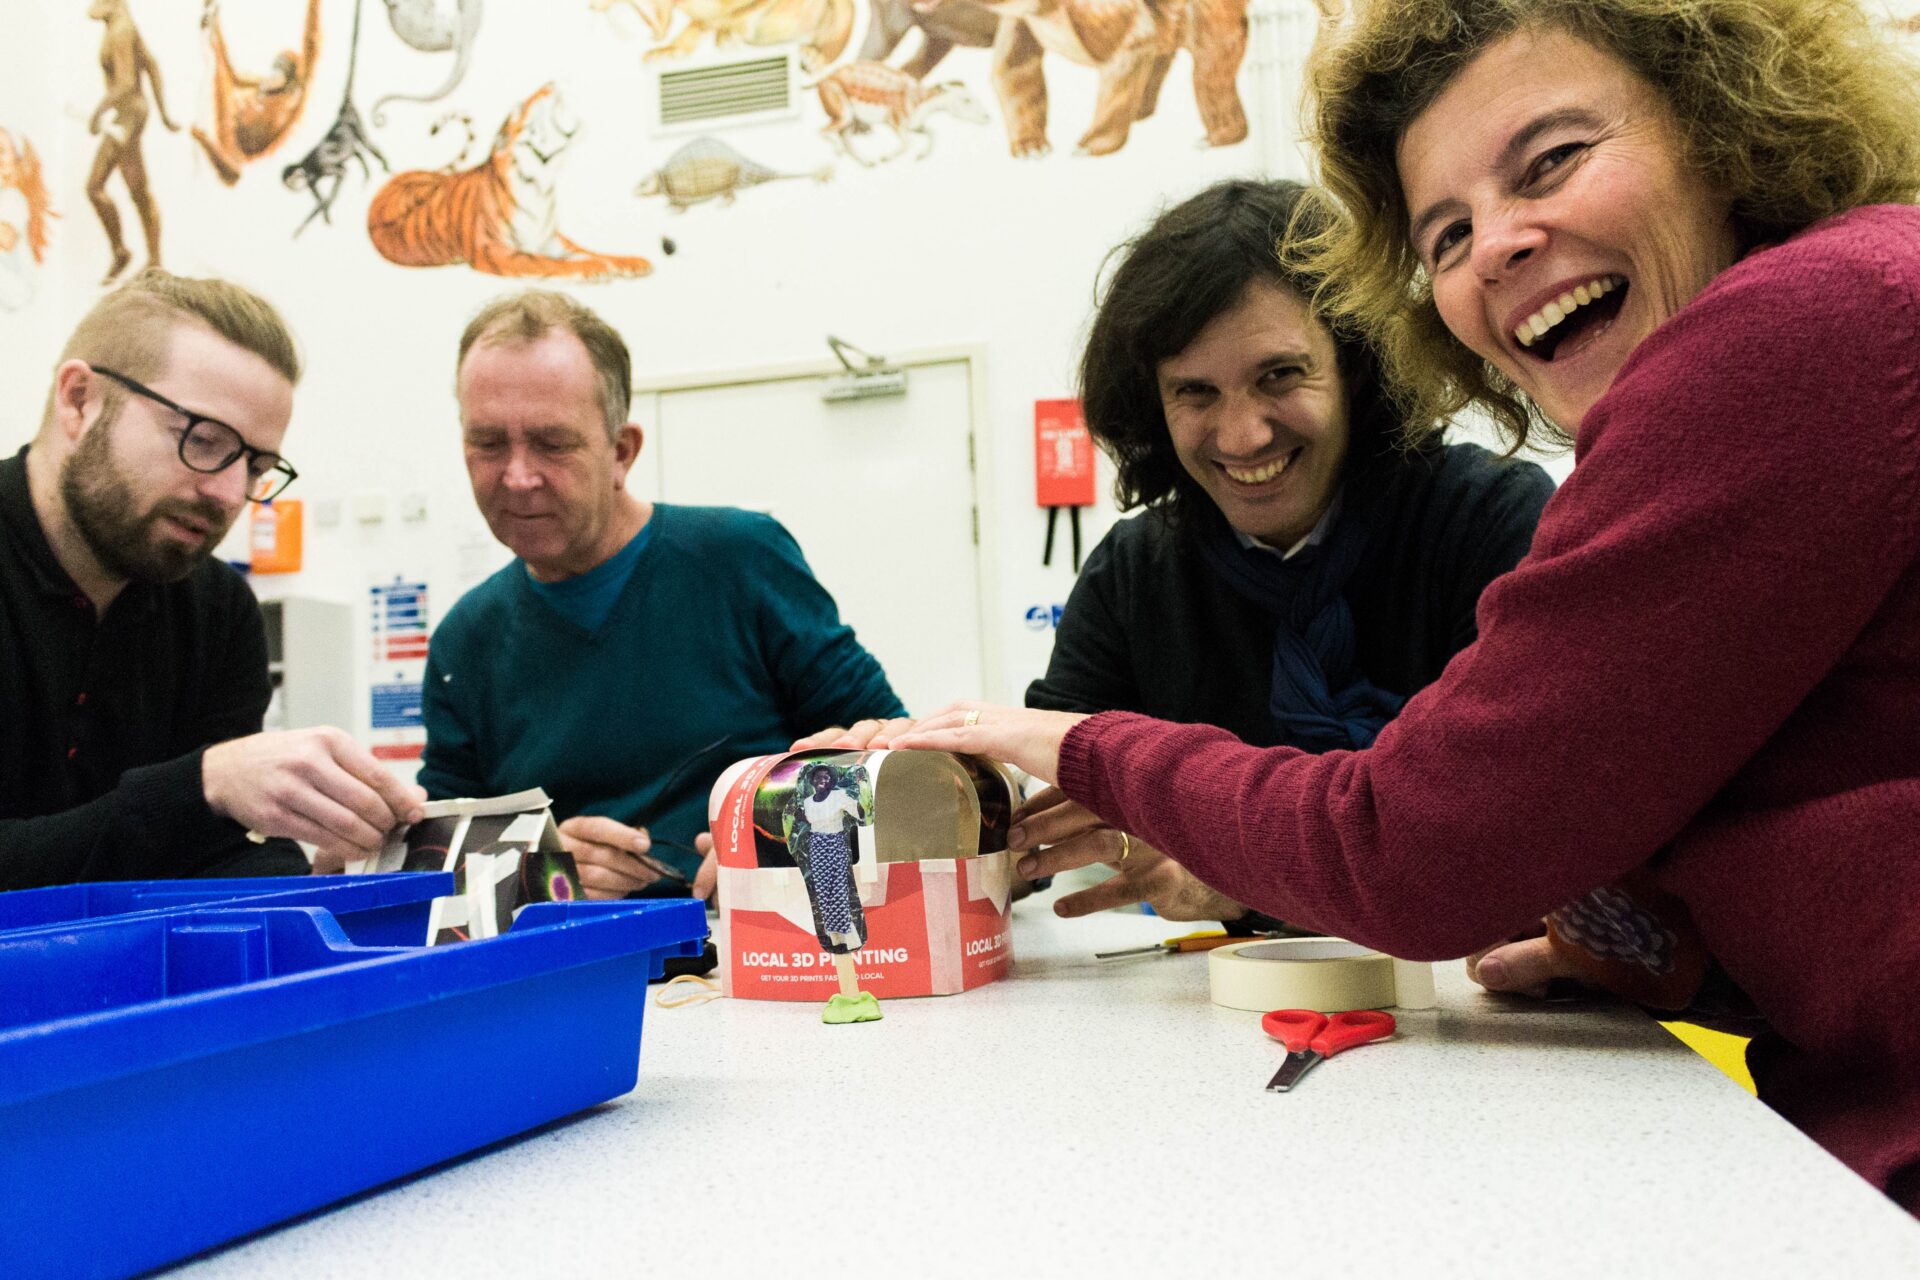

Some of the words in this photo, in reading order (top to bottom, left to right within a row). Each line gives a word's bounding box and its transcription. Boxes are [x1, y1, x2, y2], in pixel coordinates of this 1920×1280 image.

[730, 794, 743, 852] LOCAL
[743, 952, 788, 967] LOCAL
[792, 953, 815, 967] 3D
[819, 947, 908, 967] PNTING
[966, 937, 993, 957] LOCAL
[825, 974, 839, 982] FAS
[861, 972, 884, 980] LOCAL
